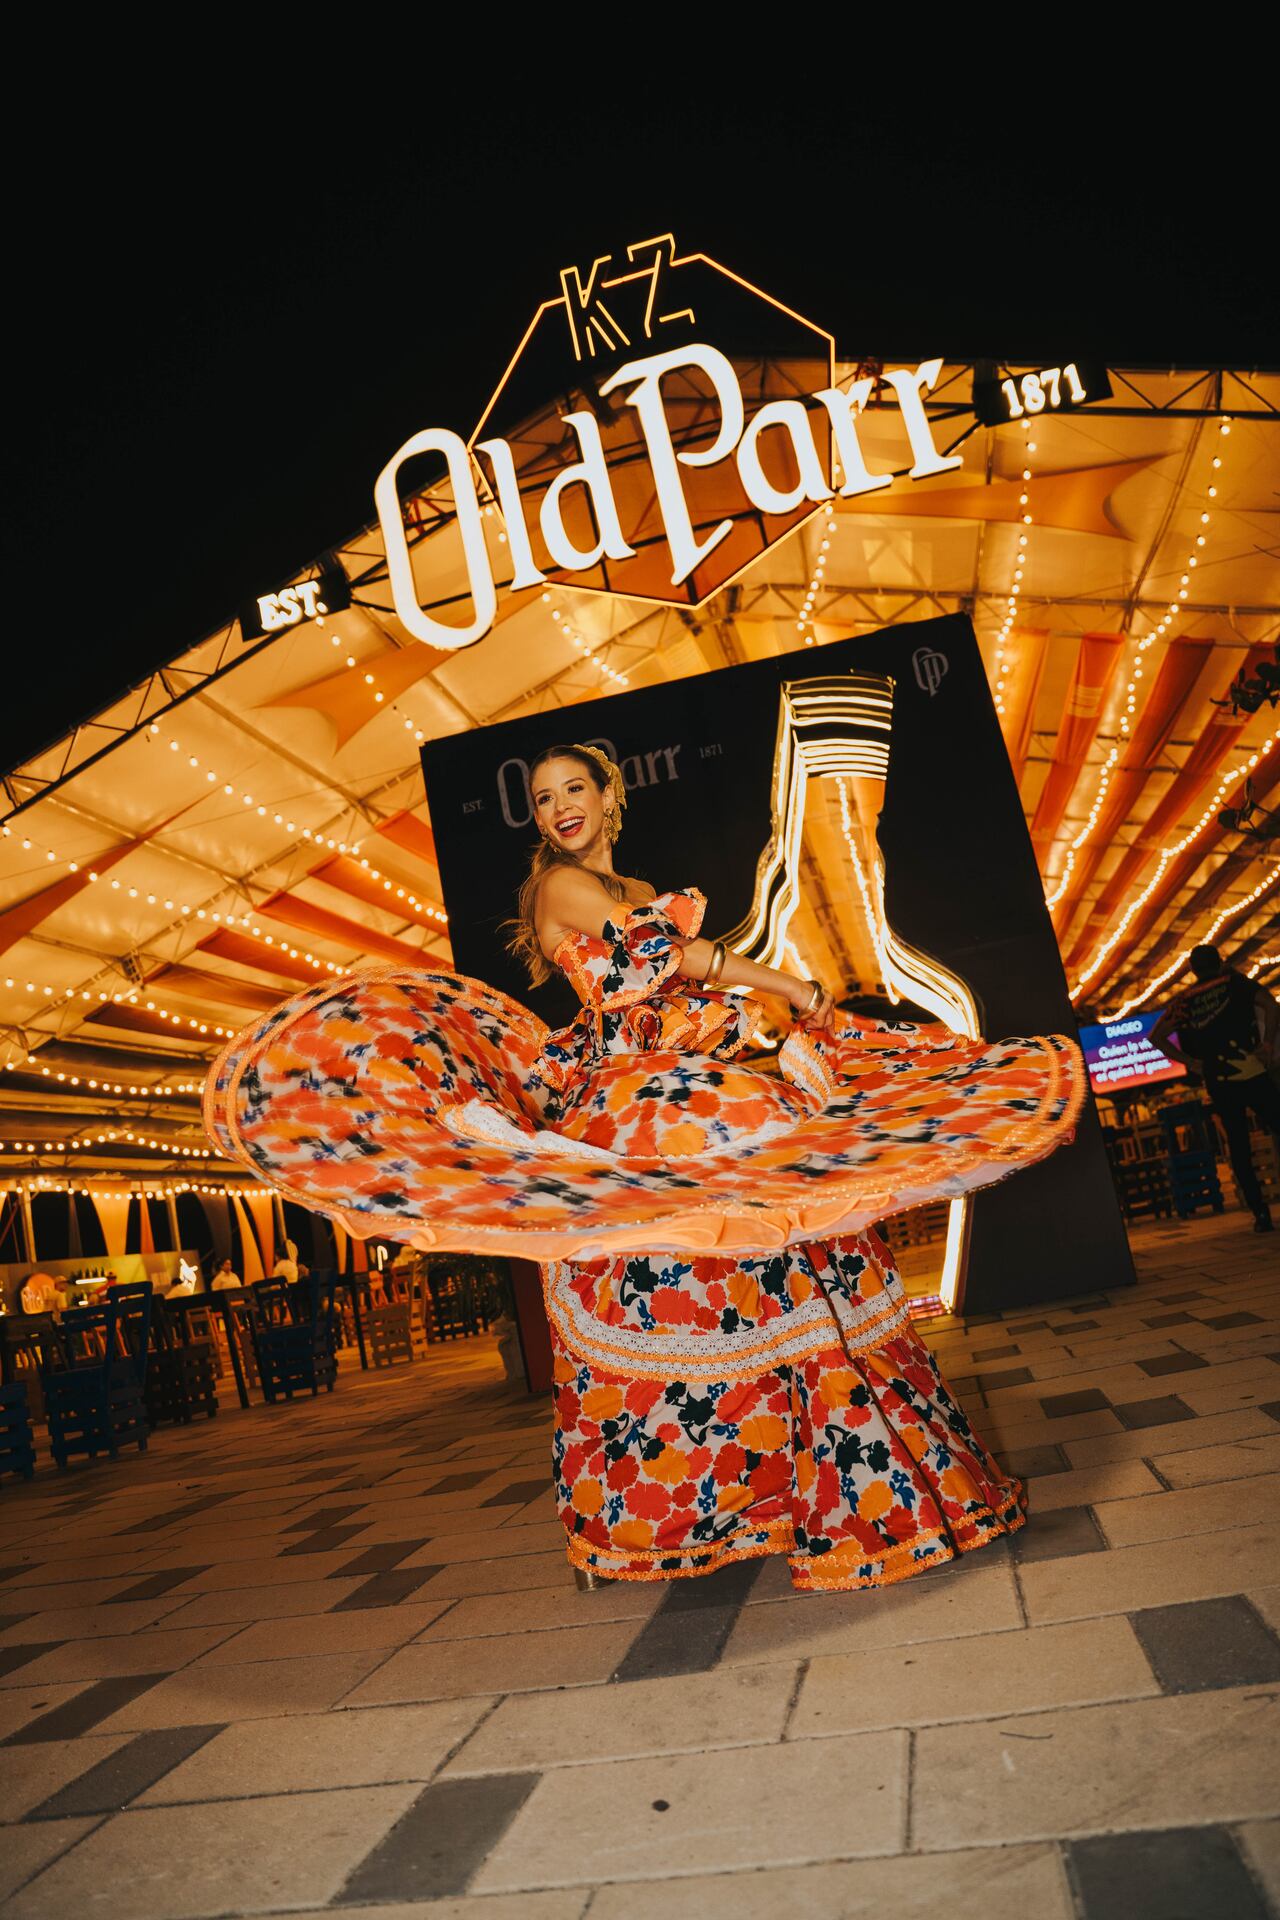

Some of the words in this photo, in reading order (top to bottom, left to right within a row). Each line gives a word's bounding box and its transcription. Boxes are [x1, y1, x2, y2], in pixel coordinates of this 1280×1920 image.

[374, 411, 637, 650] Old
[598, 343, 964, 586] Parr
[1001, 363, 1086, 418] 1871
[698, 743, 724, 760] 1871
